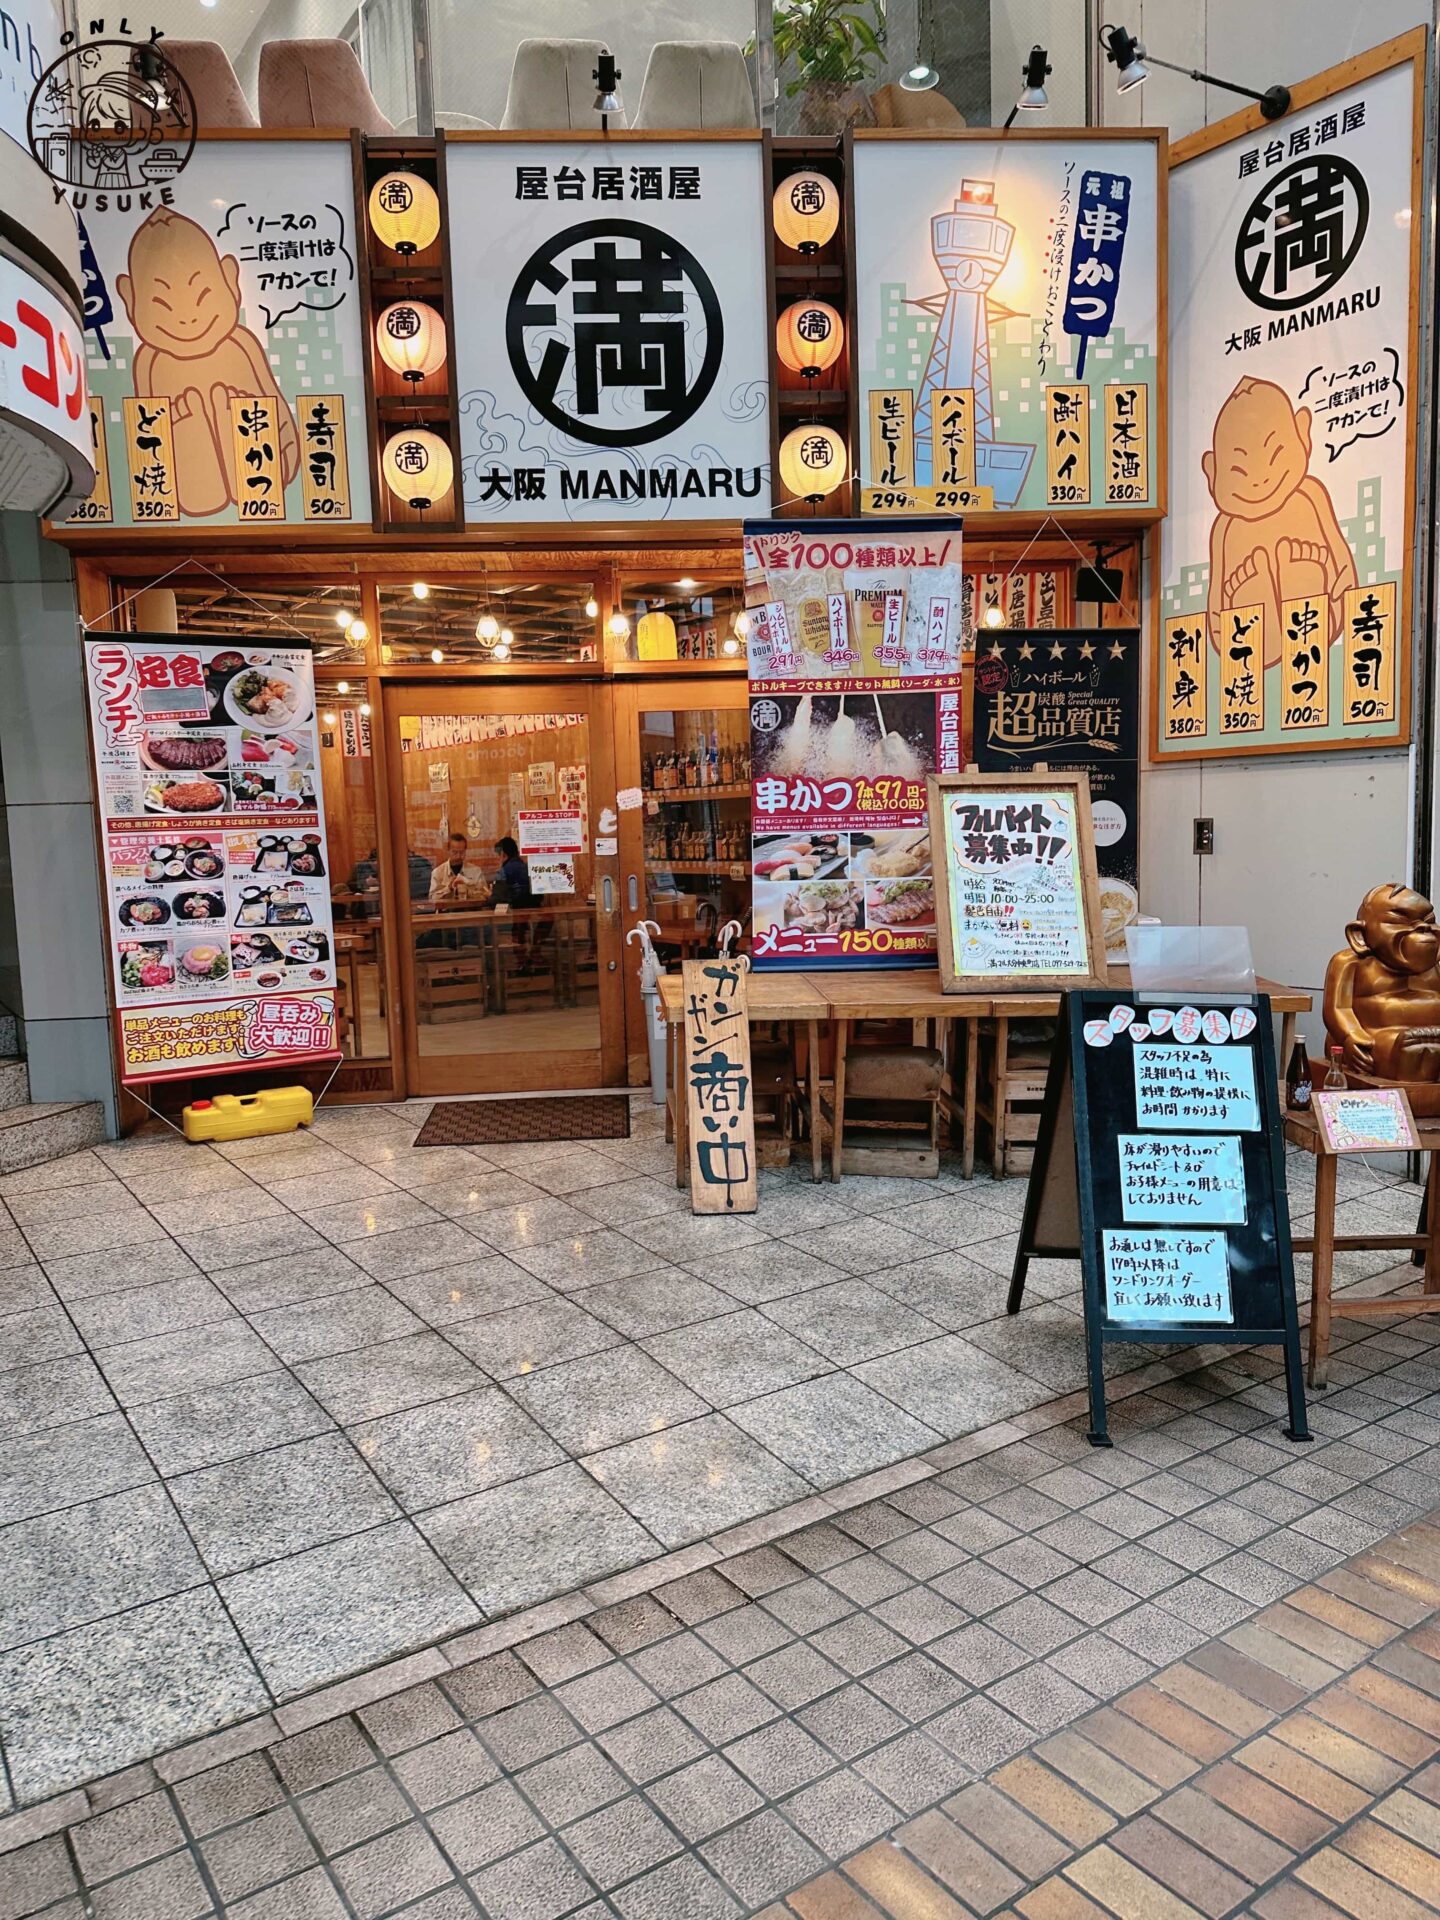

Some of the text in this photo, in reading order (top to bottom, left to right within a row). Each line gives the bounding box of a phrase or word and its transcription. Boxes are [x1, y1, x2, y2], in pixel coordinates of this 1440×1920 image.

[1238, 101, 1366, 179] 屋台居酒屋
[379, 180, 413, 213] 満
[515, 166, 701, 201] 屋台居酒屋
[791, 180, 825, 215] 満
[1085, 177, 1125, 201] 元祖
[247, 214, 317, 233] ソースの
[1235, 154, 1370, 311] 満
[239, 240, 337, 263] 二度漬けは
[1070, 203, 1124, 321] 串かつ
[387, 307, 421, 339] 満
[506, 218, 724, 447] 満
[797, 309, 831, 342] 満
[1225, 286, 1381, 355] 大阪 MANMARU
[0, 299, 82, 420] コン
[1322, 361, 1376, 387] ソースの
[1314, 378, 1390, 414] 二度漬けは
[134, 405, 173, 497] どて焼
[237, 401, 275, 496] 串かつ
[305, 403, 341, 492] 寿司
[877, 396, 908, 486] 生ビール
[940, 394, 968, 485] ハイボール
[1053, 391, 1083, 482] 酎ハイ
[1111, 389, 1142, 480] 日本酒
[395, 441, 428, 474] 満
[801, 436, 834, 469] 満
[479, 467, 762, 501] 大阪 MANMARU
[760, 533, 801, 547] ドリンク
[768, 542, 938, 570] 全100種類以上
[831, 597, 845, 647] ハイボール
[887, 599, 899, 643] 生ビール
[931, 606, 944, 643] 酎ハイ
[823, 649, 859, 662] 346円
[874, 646, 910, 660] 355円
[1287, 601, 1321, 702] 串かつ
[1352, 593, 1389, 691] 寿司
[136, 653, 205, 689] 定食
[1168, 627, 1201, 710] 刺身
[1225, 614, 1260, 707] どて焼
[97, 649, 138, 734] ランチ
[1023, 671, 1087, 685] ハイボール
[1068, 691, 1093, 699] Special
[1089, 697, 1120, 706] QUALITY
[750, 699, 782, 732] 満
[940, 693, 960, 774] 屋台居酒
[755, 778, 853, 814] 串かつ
[525, 812, 553, 820] アルコール
[956, 803, 1052, 833] アルバイト
[963, 834, 1067, 866] 募集中!!
[125, 1008, 247, 1031] 単品メニューのお料理も
[262, 1004, 321, 1024] 昼呑み
[1087, 1006, 1257, 1044] スタッフ募集中
[128, 1038, 245, 1063] お酒も飲めます!
[253, 1029, 329, 1047] 大歓迎!!
[1140, 1049, 1212, 1065] スタッフ不足の為
[1124, 1142, 1226, 1157] 床が滑りやすいので
[1126, 1175, 1240, 1192] お子様メニューの用意は
[1109, 1236, 1216, 1256] お通しは無しですので
[1111, 1256, 1180, 1272] 17時以降は
[1112, 1272, 1201, 1288] ワンドリンクオーダー
[1112, 1291, 1223, 1312] 宜しくお願い致します
